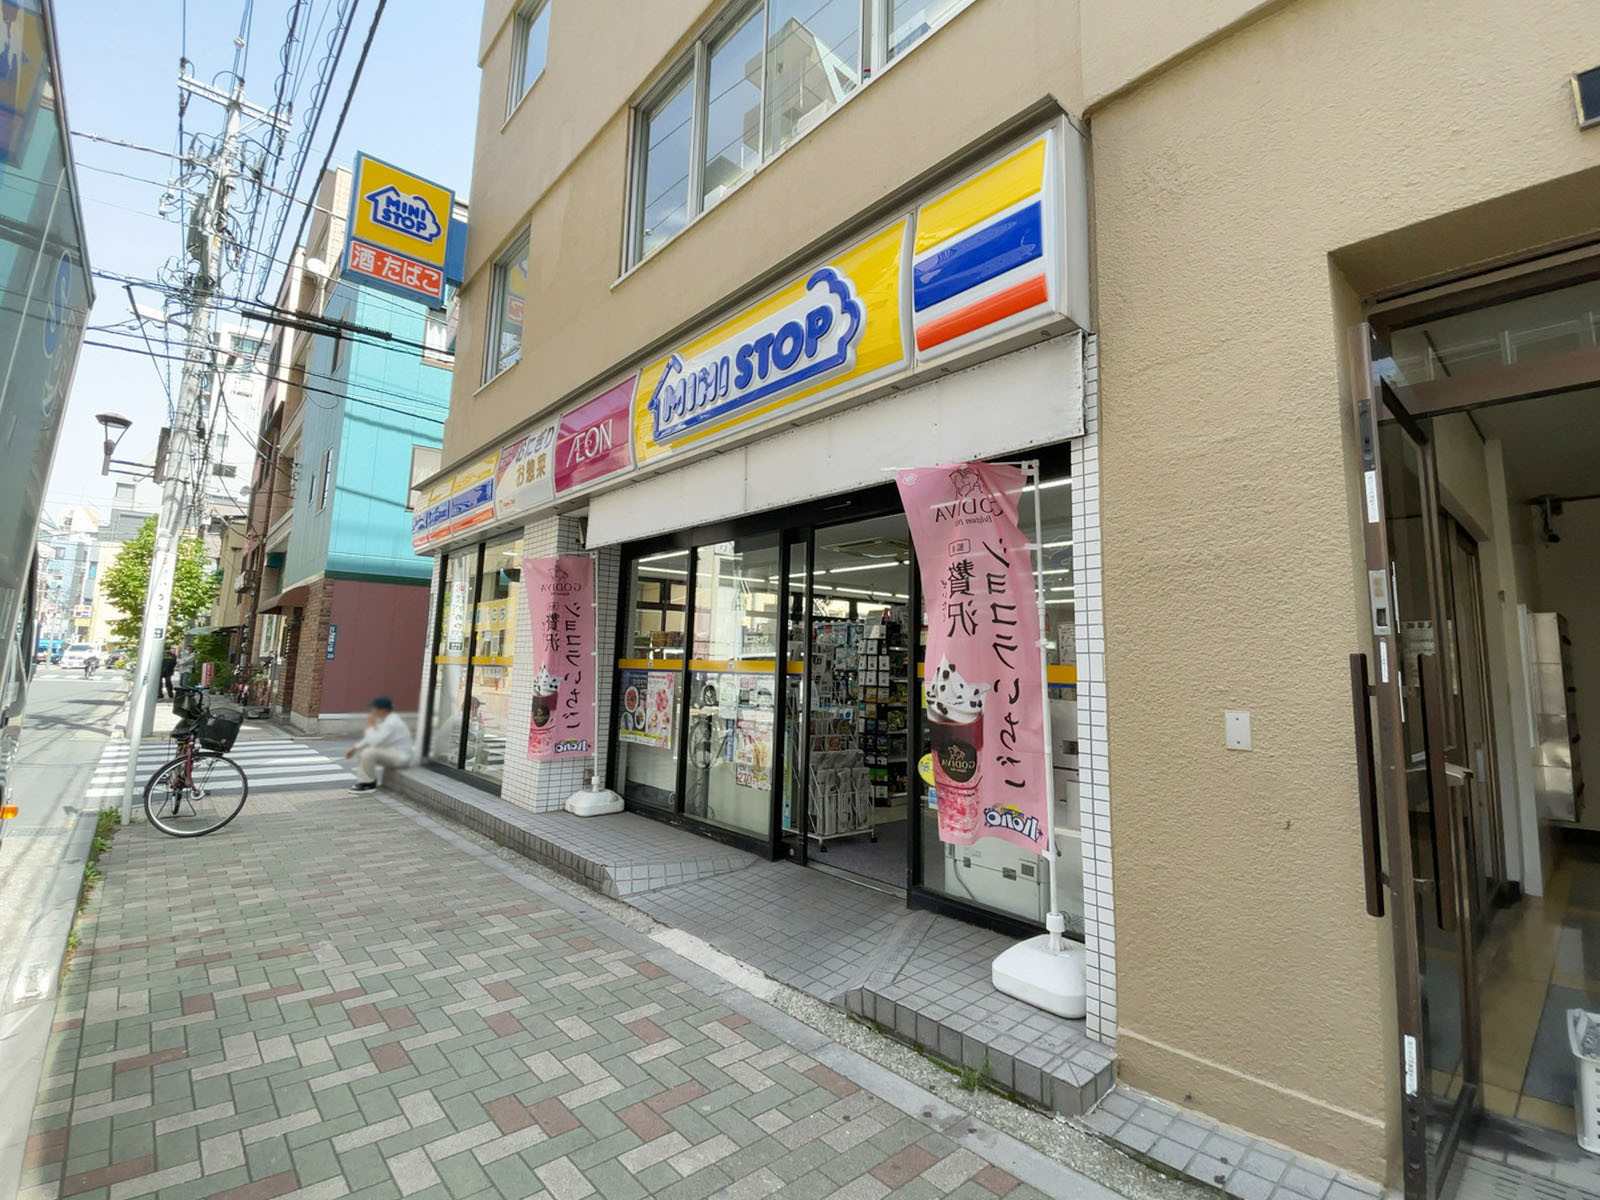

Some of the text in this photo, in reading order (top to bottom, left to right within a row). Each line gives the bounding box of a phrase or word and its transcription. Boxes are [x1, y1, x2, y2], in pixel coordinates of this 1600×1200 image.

[381, 208, 428, 233] STOP
[385, 195, 427, 221] MINI
[664, 305, 834, 422] MINI STOP
